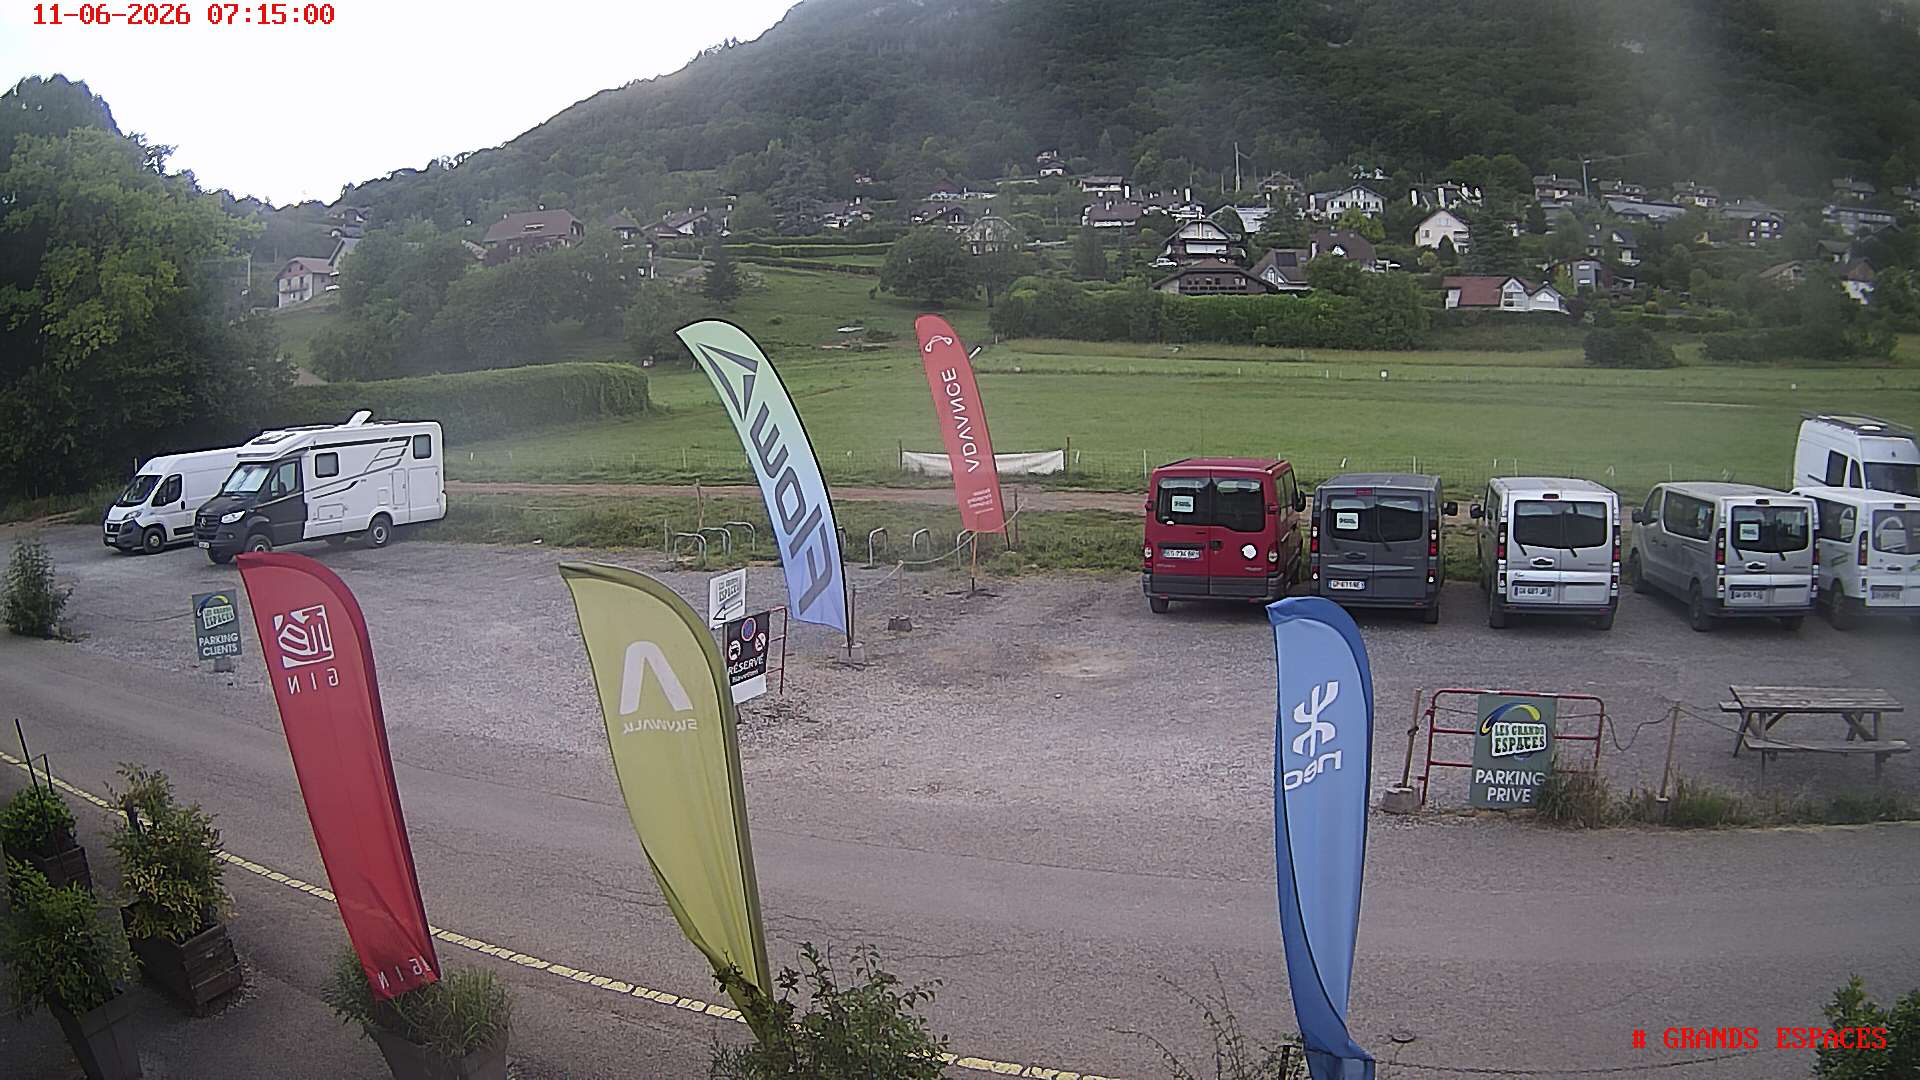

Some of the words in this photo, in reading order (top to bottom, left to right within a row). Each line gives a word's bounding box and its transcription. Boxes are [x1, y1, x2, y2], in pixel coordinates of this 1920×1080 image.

[199, 633, 239, 647] PARKING
[203, 643, 238, 656] CLIENTS
[1496, 724, 1509, 736] LES
[1511, 725, 1545, 736] GRANDS
[1495, 737, 1545, 753] ESPACES
[1475, 769, 1546, 786] PARKING
[1487, 786, 1531, 803] PRIVE
